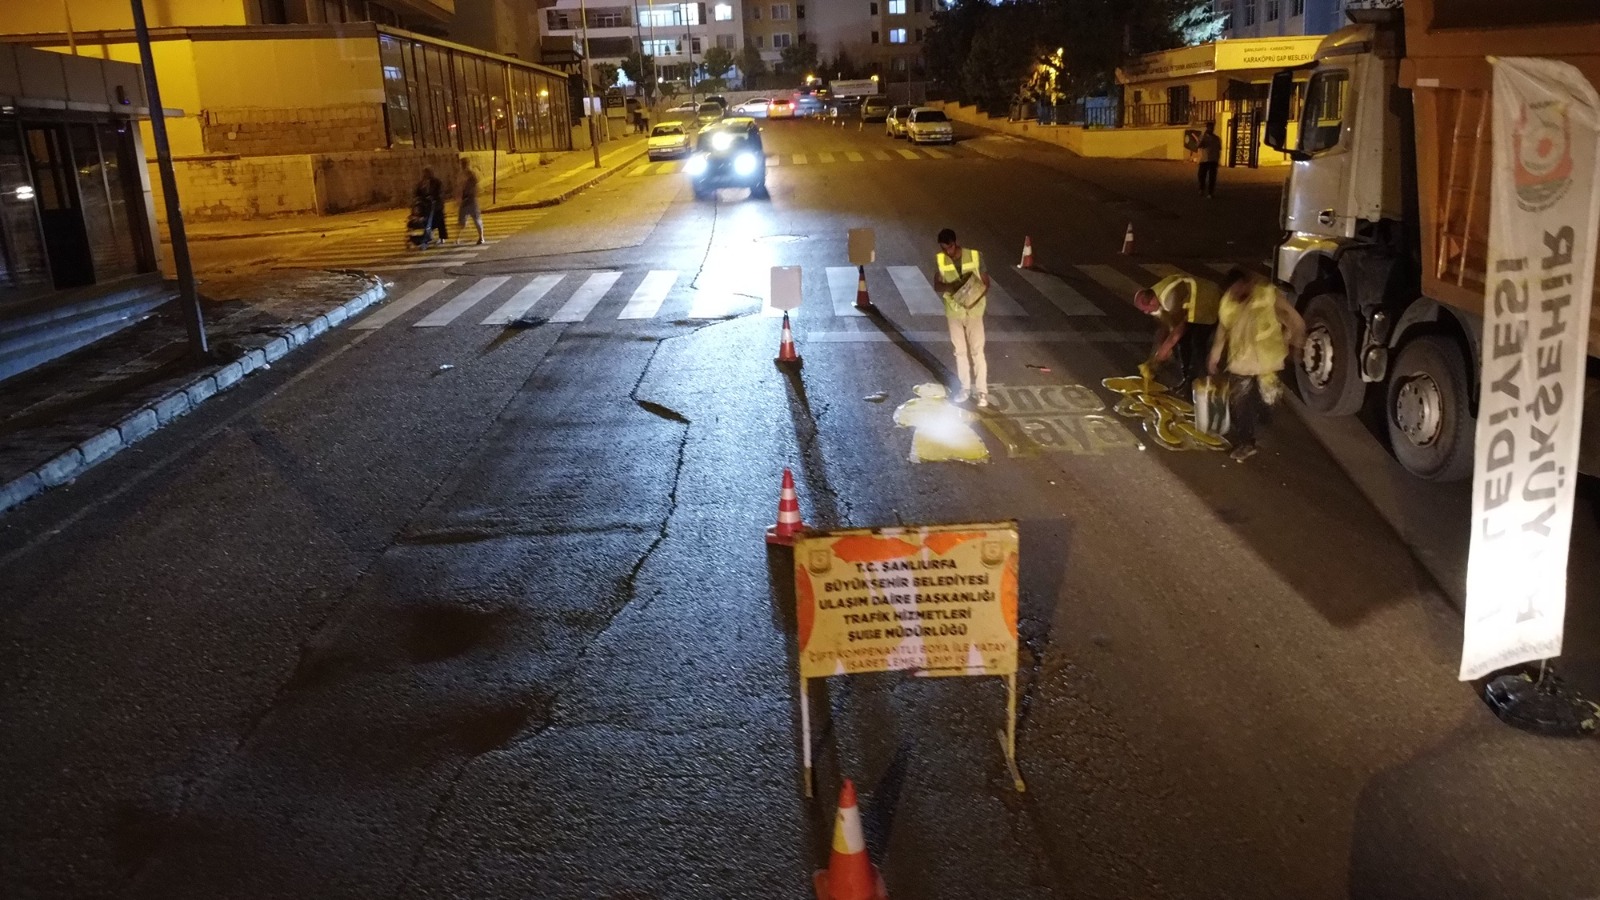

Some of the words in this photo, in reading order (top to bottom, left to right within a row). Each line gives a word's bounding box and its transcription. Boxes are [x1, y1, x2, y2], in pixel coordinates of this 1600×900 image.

[882, 559, 957, 573] ŞANLIURFA
[824, 576, 909, 592] BÜYÜKŞEHİR
[913, 572, 989, 588] BELEDİYESİ
[818, 597, 869, 610] ULAŞIM
[871, 593, 911, 606] DAİRE
[915, 589, 995, 604] BAŞKANLIĞI
[843, 611, 890, 625] TRAFİK
[893, 607, 972, 622] HİZMETLERİ
[848, 629, 882, 643] ŞUBE
[885, 623, 968, 639] MÜDÜRLÜĞÜ
